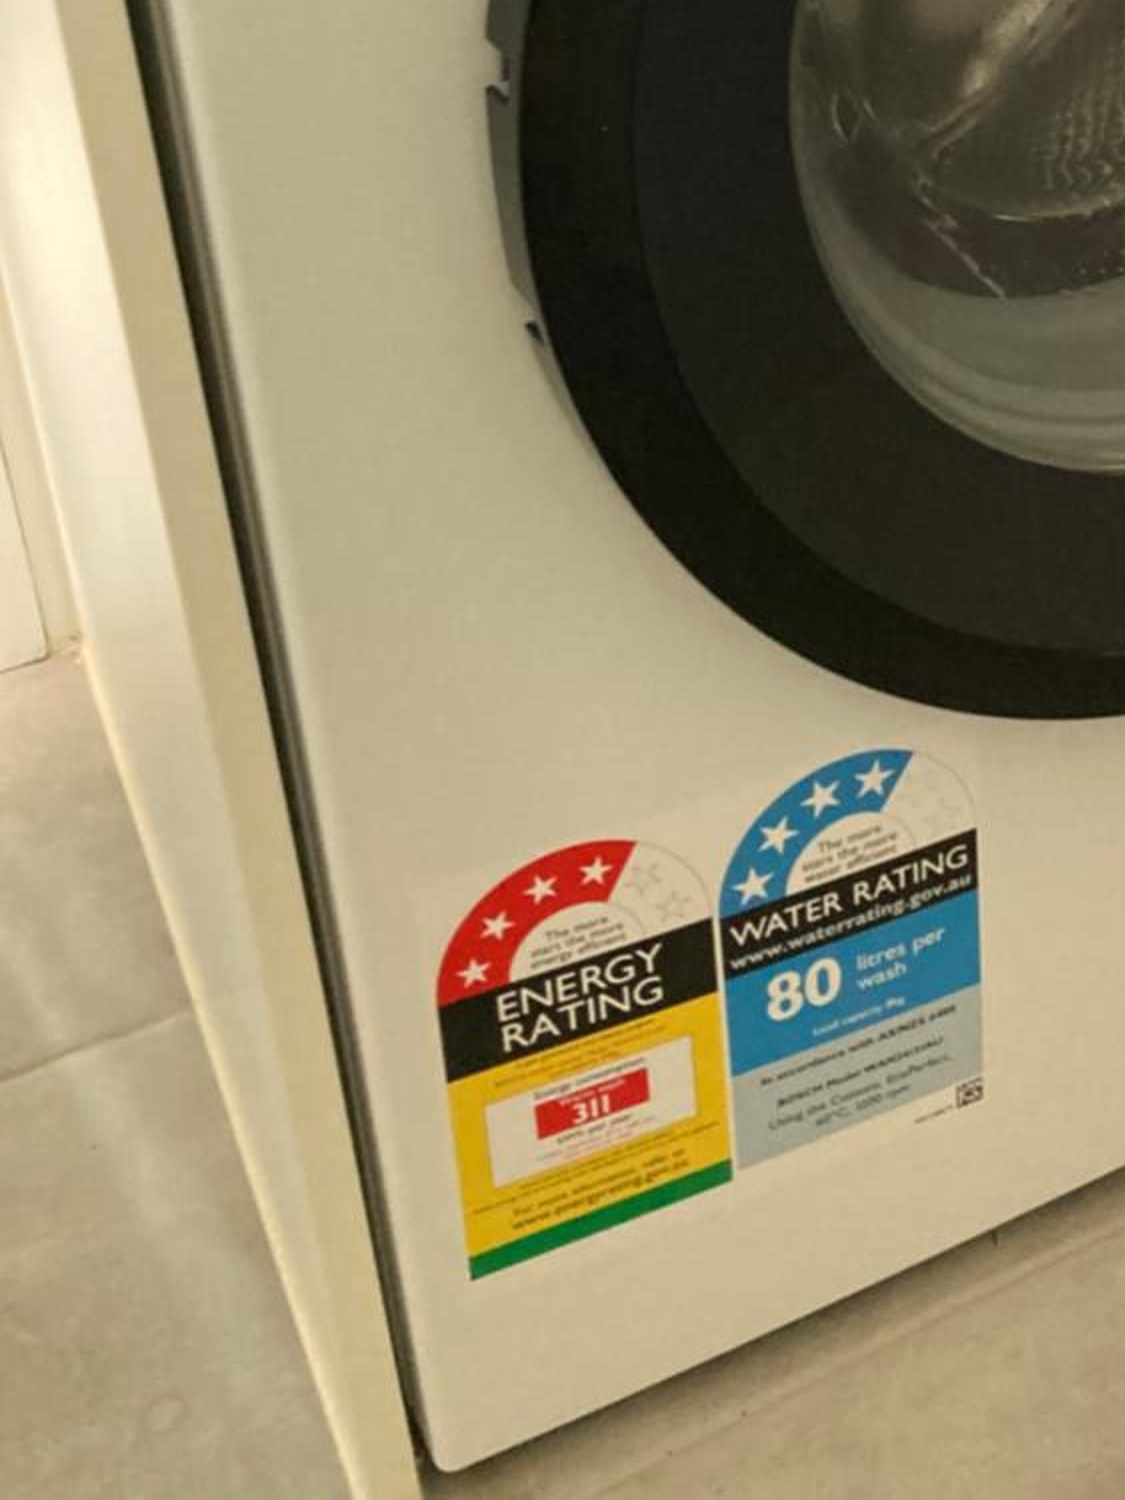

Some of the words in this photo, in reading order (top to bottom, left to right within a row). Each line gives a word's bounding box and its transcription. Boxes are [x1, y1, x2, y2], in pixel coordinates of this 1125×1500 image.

[818, 841, 842, 853] The
[847, 826, 883, 842] more
[729, 891, 844, 947] WATER
[852, 844, 969, 905] RATING
[729, 874, 972, 971] www.waterrating.gov.au
[545, 928, 569, 940] The
[573, 916, 609, 932] more
[855, 941, 907, 971] litres
[912, 927, 946, 956] per
[496, 942, 663, 1023] ENERGY
[766, 957, 843, 1023] 80
[857, 962, 908, 991] wash
[501, 975, 664, 1054] RATING
[572, 1093, 612, 1126] 311
